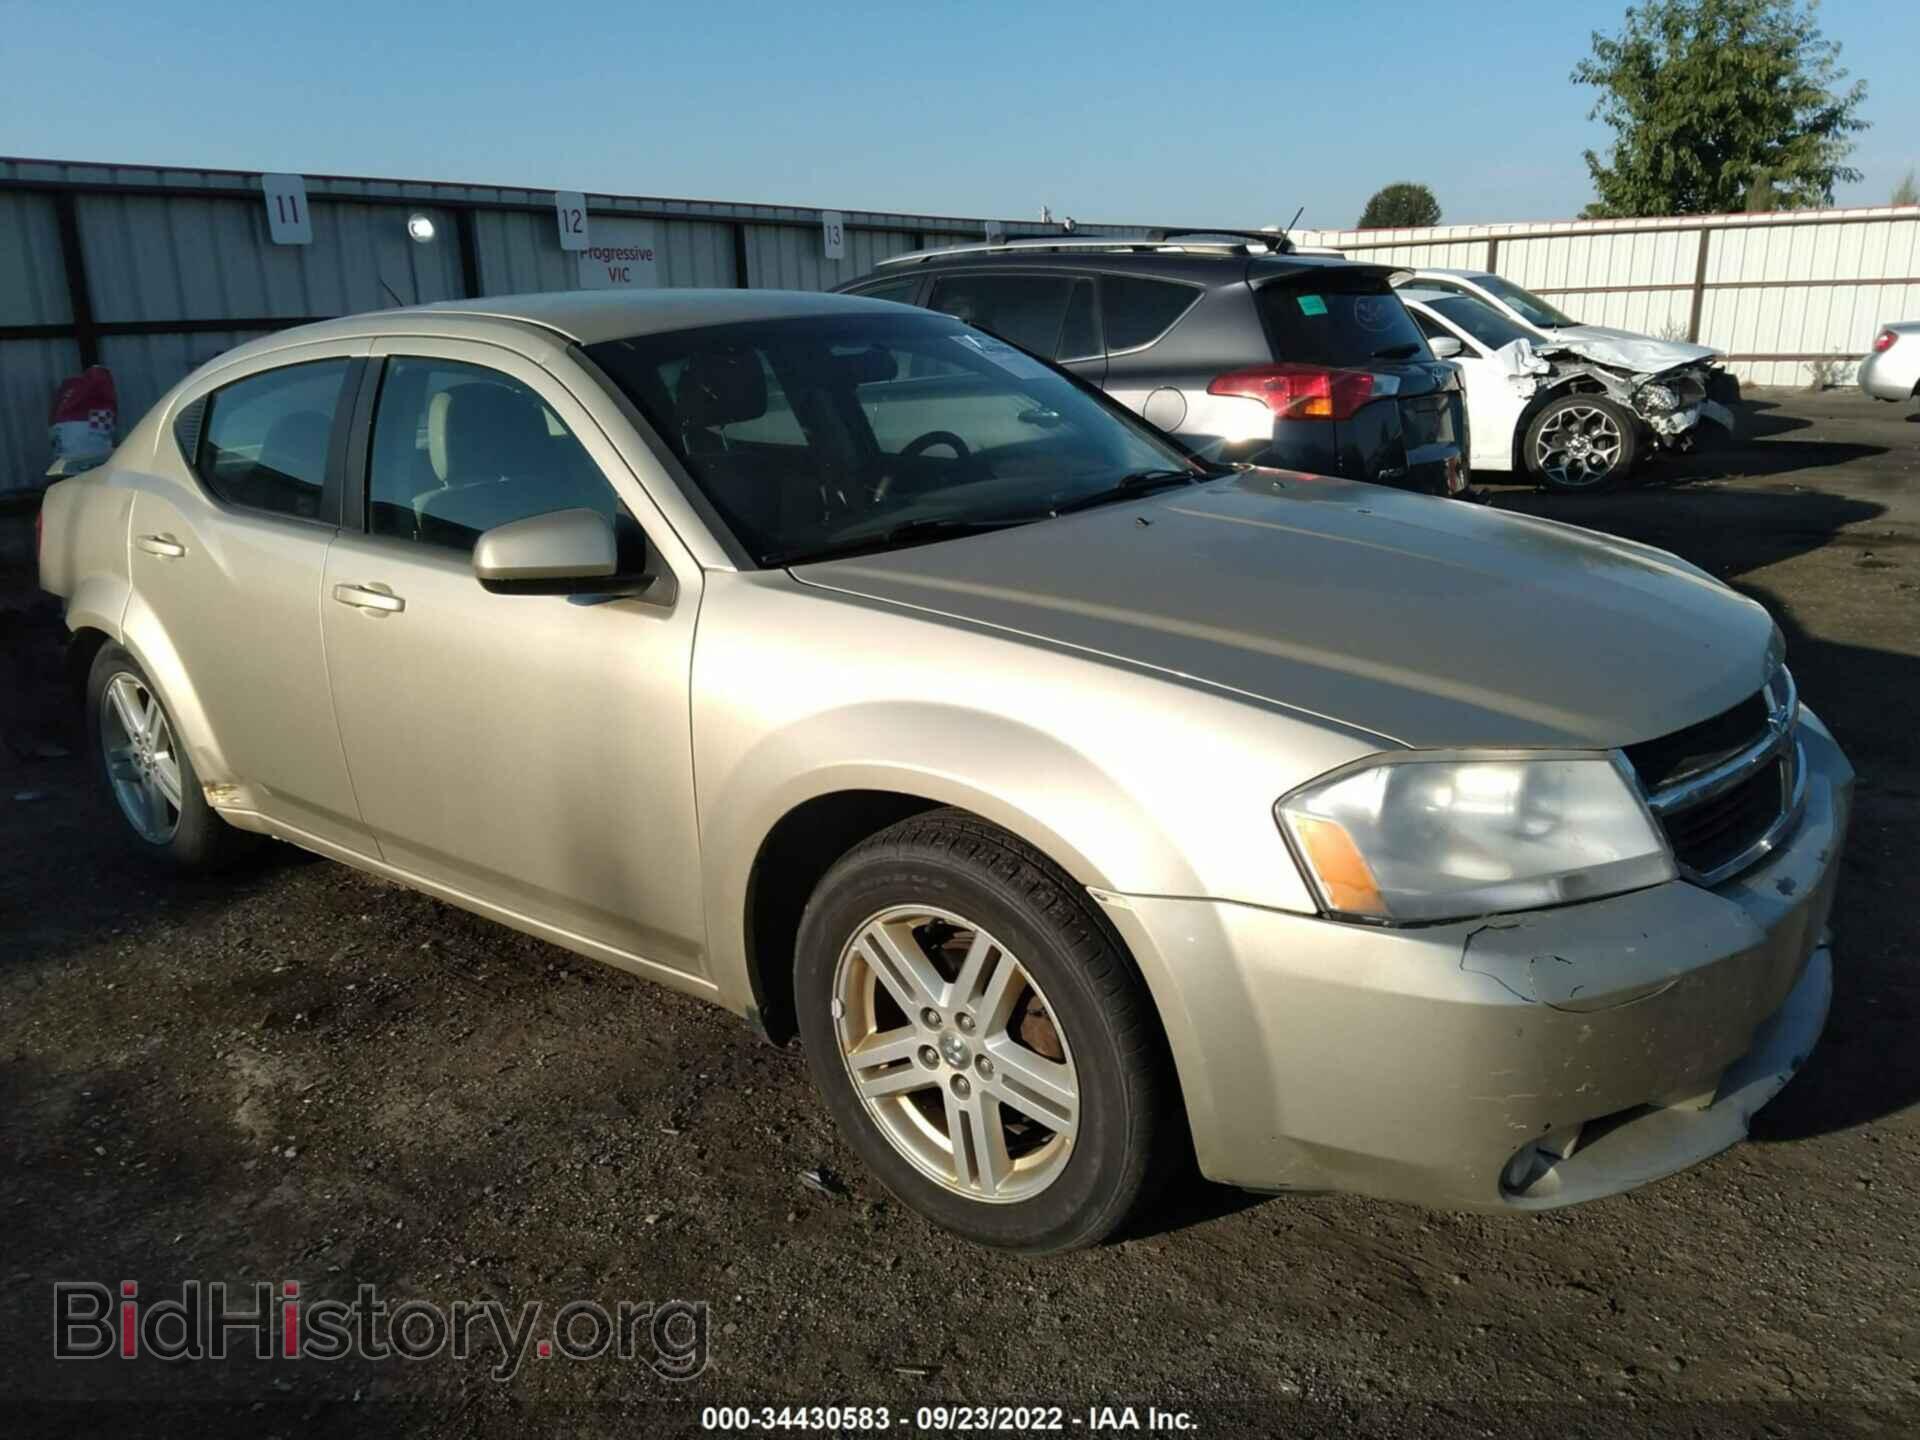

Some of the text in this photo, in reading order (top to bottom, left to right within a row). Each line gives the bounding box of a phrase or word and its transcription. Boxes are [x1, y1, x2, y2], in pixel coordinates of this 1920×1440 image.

[276, 194, 300, 225] 11
[562, 208, 585, 234] 12
[826, 224, 841, 246] 13
[608, 266, 632, 283] VIC
